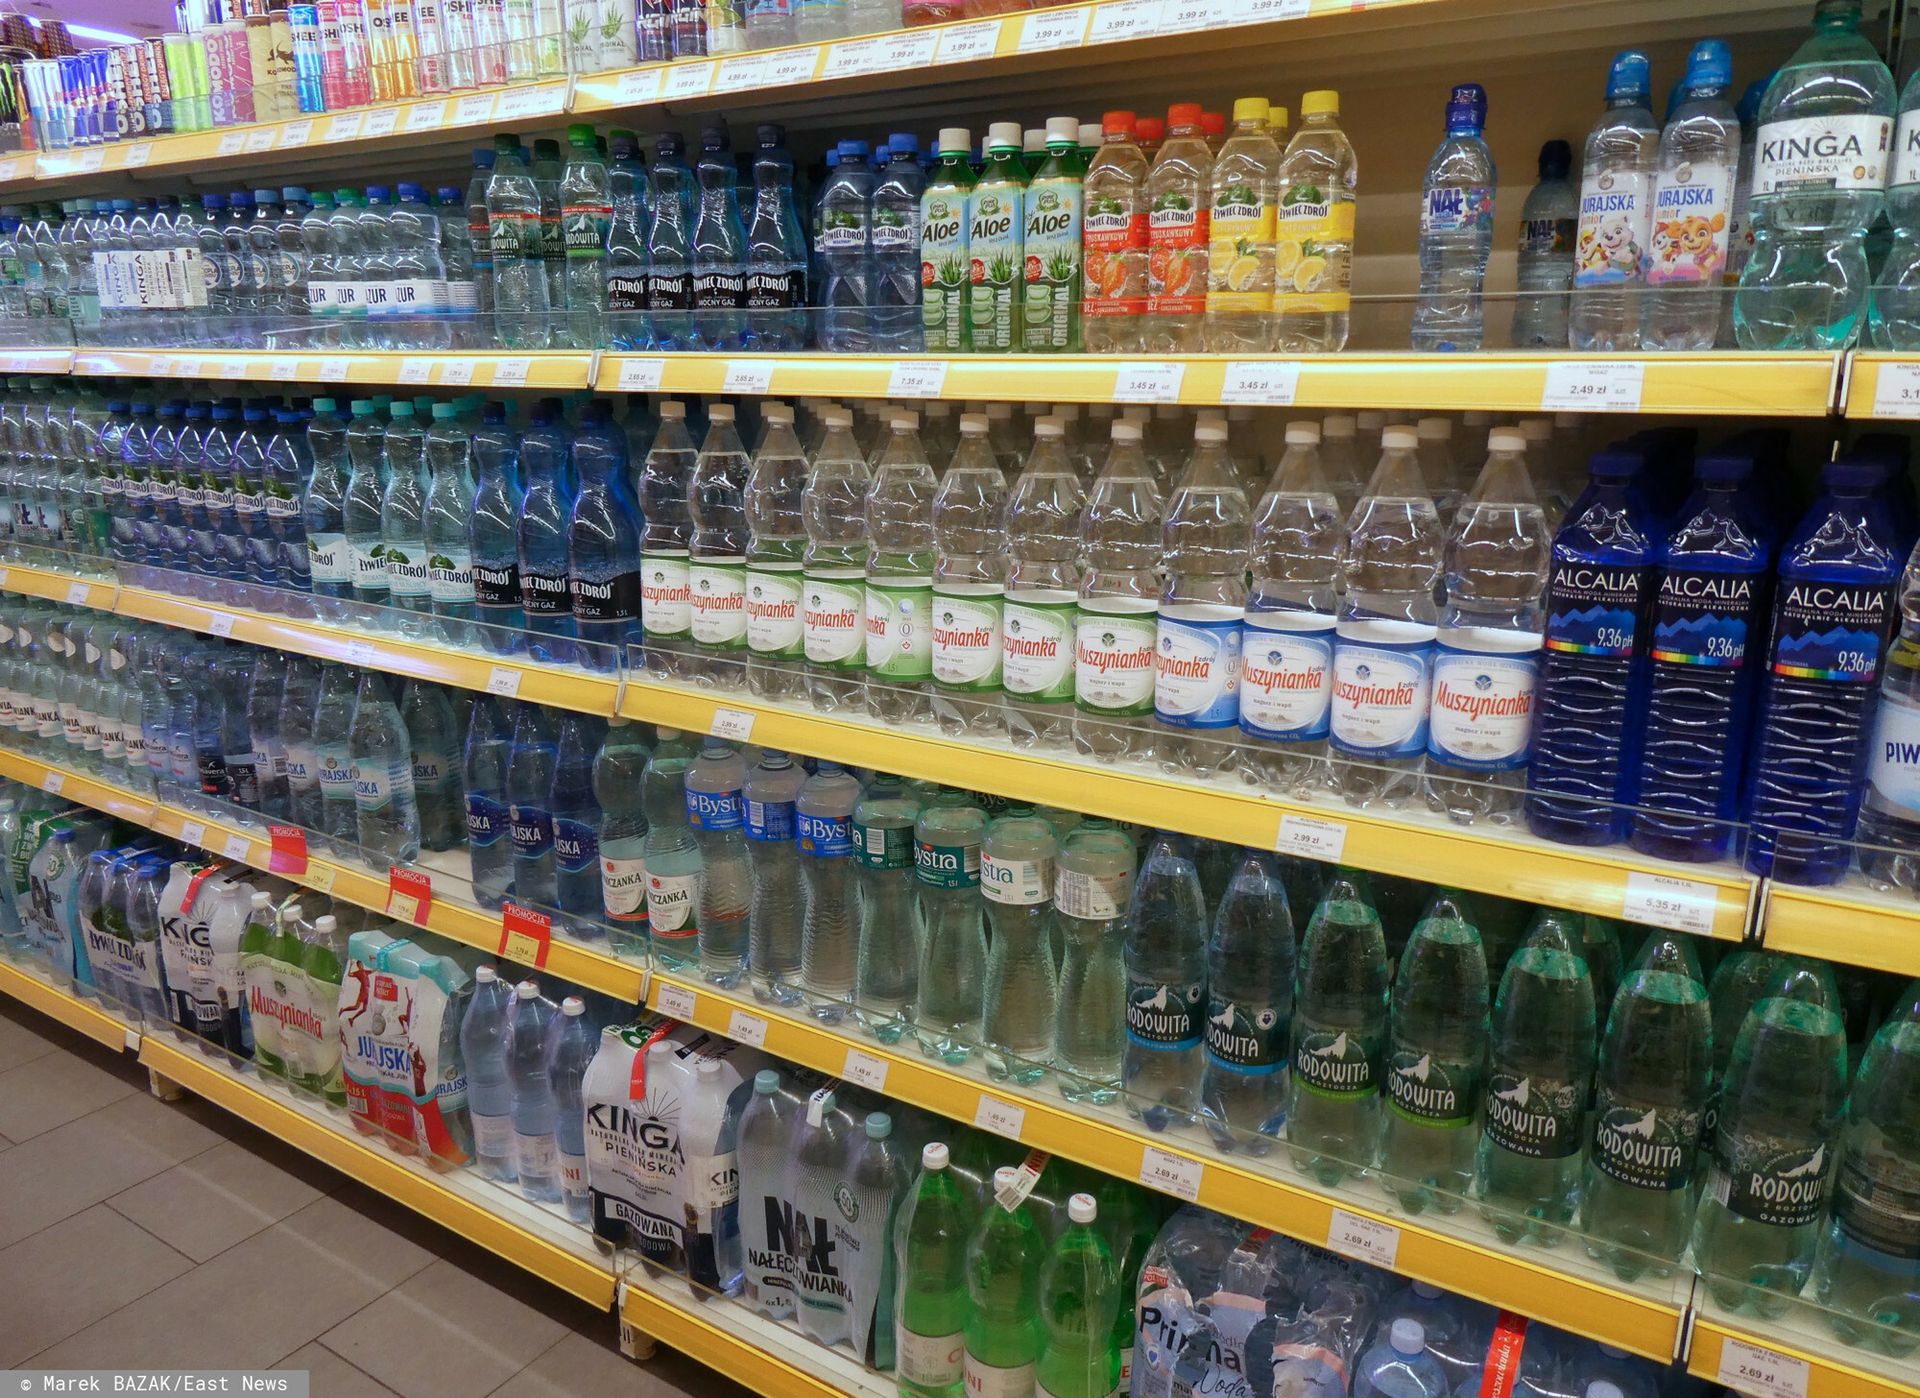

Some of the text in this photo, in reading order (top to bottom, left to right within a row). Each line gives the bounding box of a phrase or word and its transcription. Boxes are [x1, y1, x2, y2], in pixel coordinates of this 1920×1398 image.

[1106, 19, 1124, 30] 3.99
[1177, 10, 1197, 20] 3.99
[1035, 30, 1052, 39] 3.99
[1761, 133, 1863, 164] KINGA
[1429, 188, 1464, 217] NAŁ
[1581, 194, 1636, 213] JURAJSKA
[1656, 187, 1713, 209] JURAJSKA
[1106, 215, 1128, 228] ZDRÓJ
[1171, 210, 1194, 224] ZDRÓJ
[1213, 205, 1261, 220] ŻYWIEC ZDRÓJ
[1279, 204, 1328, 220] ŻYWIEC ZDRÓJ
[923, 221, 960, 244] Aloe
[971, 216, 1010, 242] Aloe
[1028, 211, 1071, 239] Aloe
[134, 253, 148, 305] KINGA
[617, 277, 645, 294] ZDRÓJ
[656, 277, 683, 294] ZDRÓJ
[716, 275, 744, 293] ZDRÓJ
[761, 275, 789, 293] ZDRÓJ
[622, 300, 636, 308] GAZ
[660, 299, 673, 308] GAZ
[722, 298, 736, 307] GAZ
[766, 298, 780, 306] GAZ
[946, 289, 961, 347] ORIGINAL
[996, 287, 1011, 347] ORIGINAL
[1052, 285, 1070, 347] ORIGINAL
[901, 377, 915, 385] 7.35
[1129, 381, 1147, 390] 3.45
[1239, 381, 1258, 390] 3.45
[1570, 385, 1594, 394] 2.49
[276, 498, 299, 513] ZDRÓJ
[310, 552, 335, 568] ZDRÓJ
[398, 562, 428, 579] ZDRÓJ
[442, 569, 473, 585] ZDRÓJ
[481, 568, 509, 587] ZDRÓJ
[1553, 567, 1640, 592] ALCALIA
[533, 573, 566, 594] ZDRÓJ
[580, 581, 612, 600] ZDRÓJ
[1660, 575, 1751, 600] ALCALIA
[486, 592, 500, 602] GAZ
[540, 600, 556, 610] GAZ
[1786, 585, 1886, 611] ALCALIA
[585, 607, 601, 617] GAZ
[804, 608, 855, 631] szynianka
[1003, 634, 1057, 659] szynianka
[1597, 627, 1622, 648] 9.36
[1707, 636, 1733, 659] 9.36
[1837, 650, 1865, 673] 9.36
[1435, 680, 1531, 722] Muszynianka
[1294, 832, 1310, 843] 2.99
[392, 866, 428, 885] PROMOCJA
[1646, 898, 1669, 910] 5.35
[507, 904, 546, 926] PROMOCJA
[1127, 1000, 1191, 1034] RODOWITA
[1298, 1052, 1370, 1082] RODOWITA
[587, 1102, 686, 1166] KINGA
[1487, 1126, 1542, 1156] GAZOWANA
[1596, 1122, 1681, 1168] RODOWITA
[1155, 1167, 1170, 1178] 2.69
[1601, 1161, 1667, 1189] GAZOWANA
[615, 1202, 676, 1241] GAZOWANA
[1344, 1232, 1362, 1245] 2.69
[1739, 1364, 1762, 1379] 2.69
